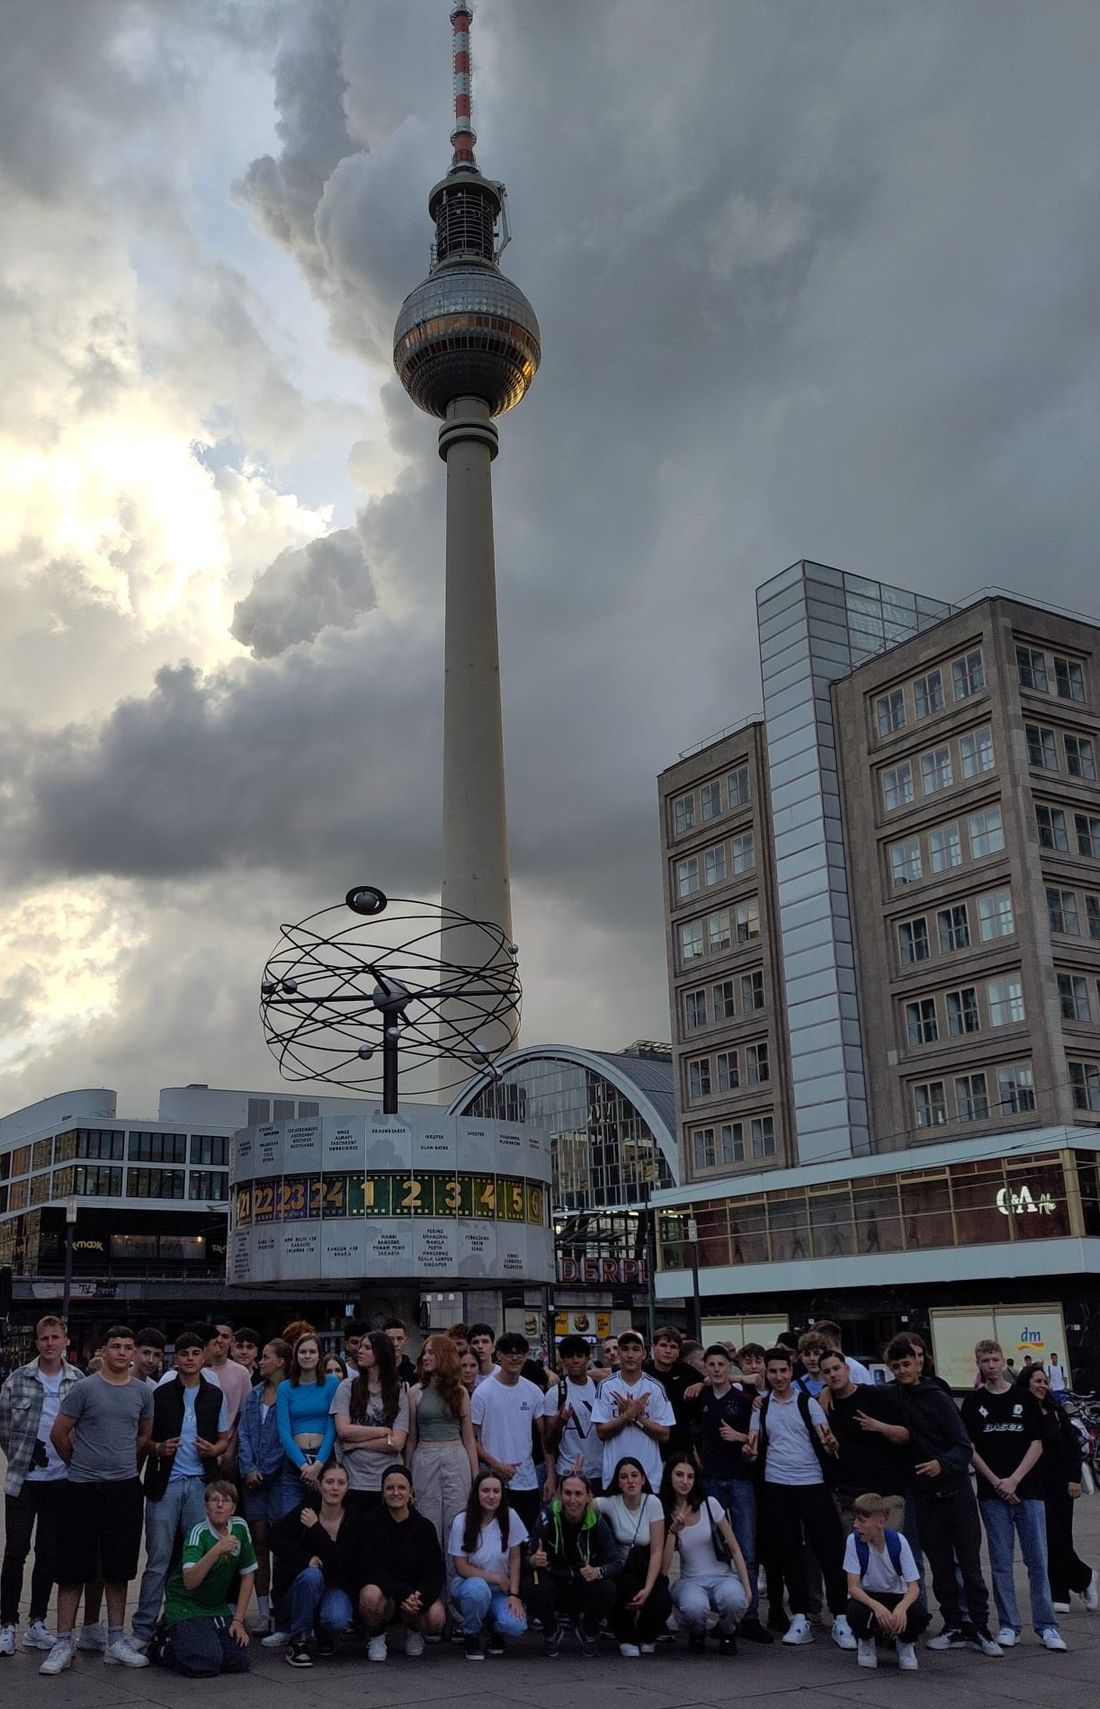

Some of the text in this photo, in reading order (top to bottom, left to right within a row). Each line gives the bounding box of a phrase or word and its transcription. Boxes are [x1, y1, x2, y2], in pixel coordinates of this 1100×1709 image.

[254, 1187, 273, 1214] 22
[277, 1184, 304, 1211] 23
[310, 1182, 343, 1208] 24
[361, 1182, 374, 1206] 1
[401, 1181, 422, 1206] 2
[445, 1182, 462, 1208] 3
[481, 1185, 495, 1210] 4
[512, 1188, 523, 1212] 5
[1021, 1327, 1041, 1342] dm
